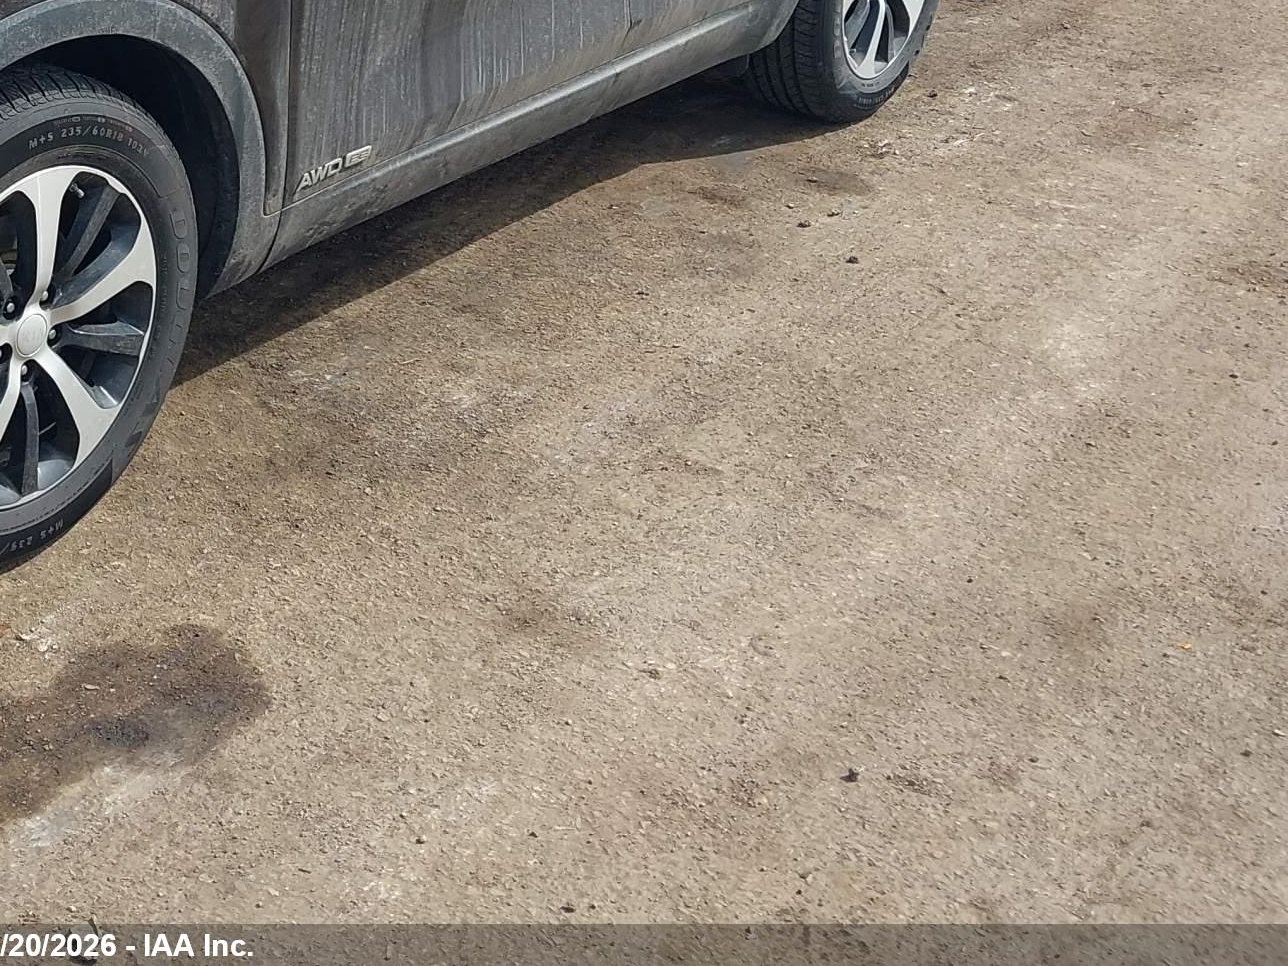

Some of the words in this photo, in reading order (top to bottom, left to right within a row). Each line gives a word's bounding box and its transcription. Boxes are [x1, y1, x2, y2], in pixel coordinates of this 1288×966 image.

[28, 131, 54, 151] M+S
[60, 125, 124, 142] 235/60R18
[296, 157, 343, 192] AWD
